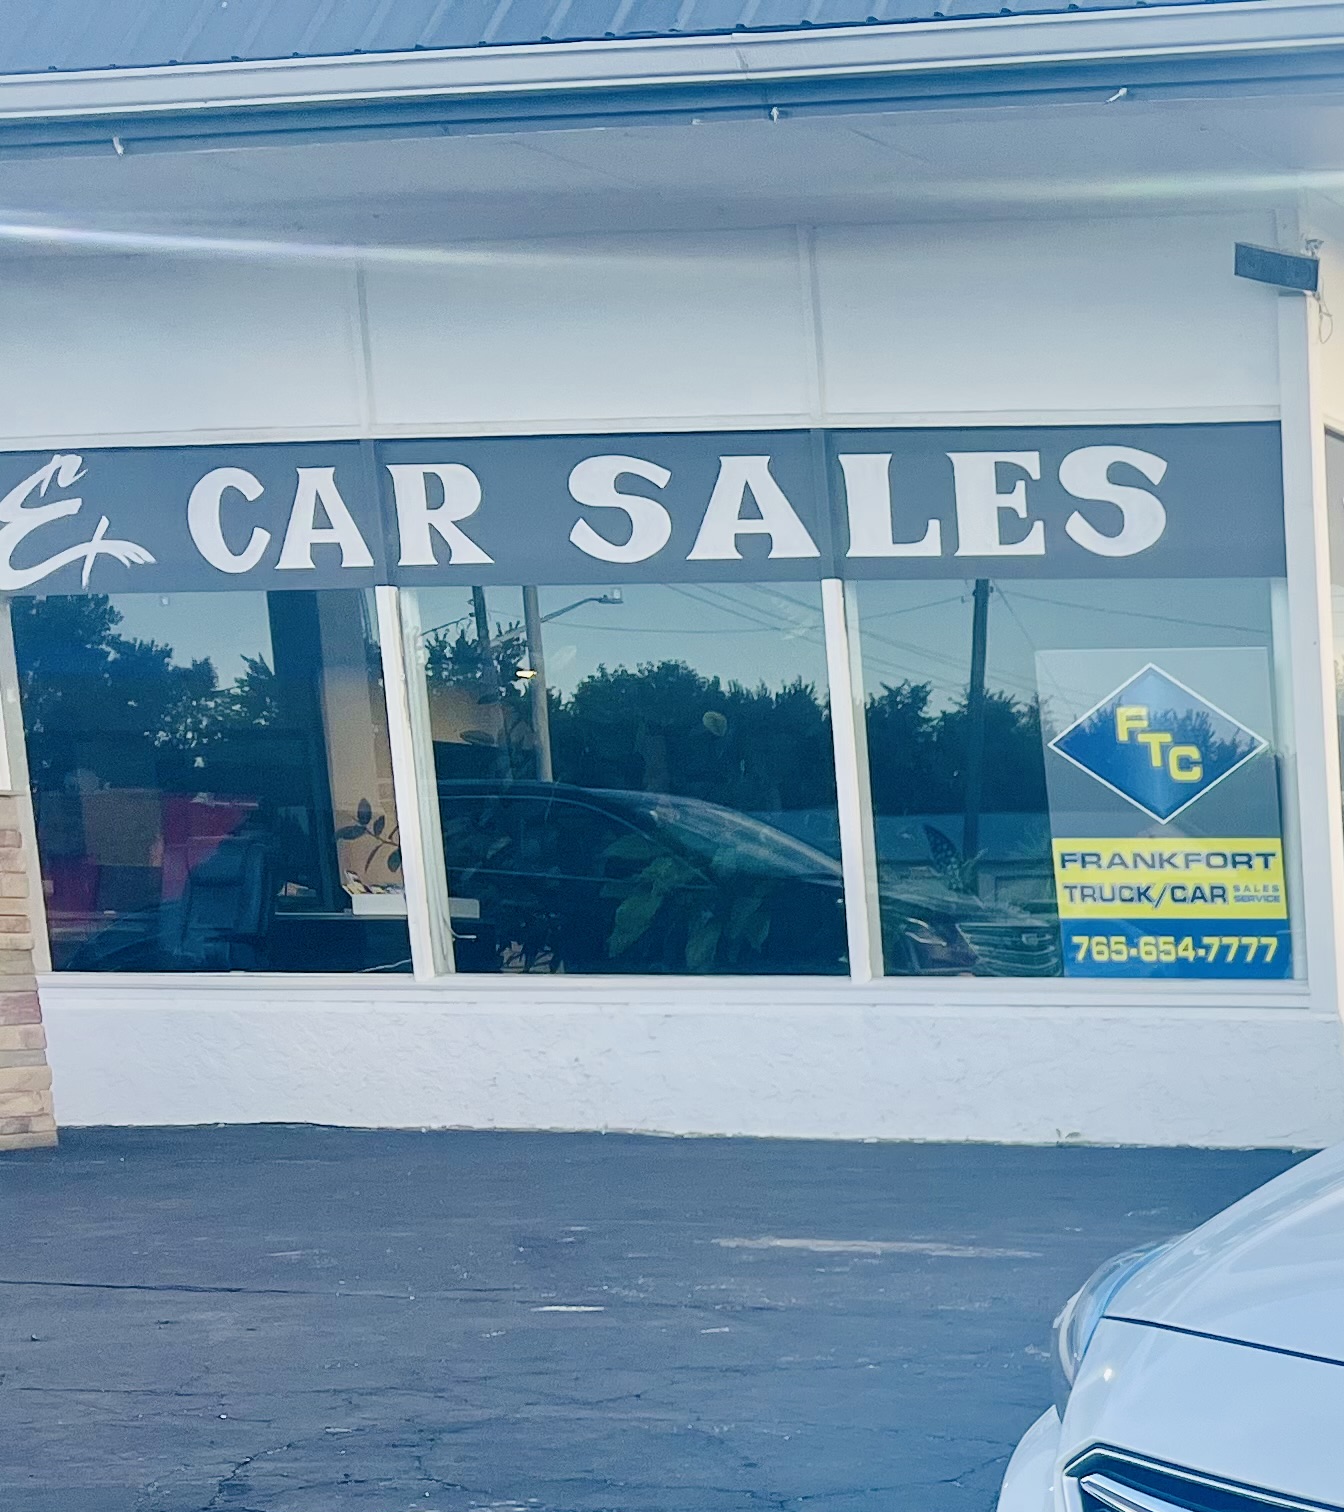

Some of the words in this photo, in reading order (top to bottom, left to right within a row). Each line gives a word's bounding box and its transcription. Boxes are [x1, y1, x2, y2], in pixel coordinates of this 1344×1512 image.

[187, 462, 495, 574] CAR
[568, 445, 1169, 564] SALES
[1115, 706, 1203, 782] FTC
[1060, 852, 1276, 870] FRANKFORT
[1063, 884, 1227, 909] TRUCK/CAR
[1233, 884, 1280, 893] SALES
[1072, 936, 1279, 963] 765-654-7777
